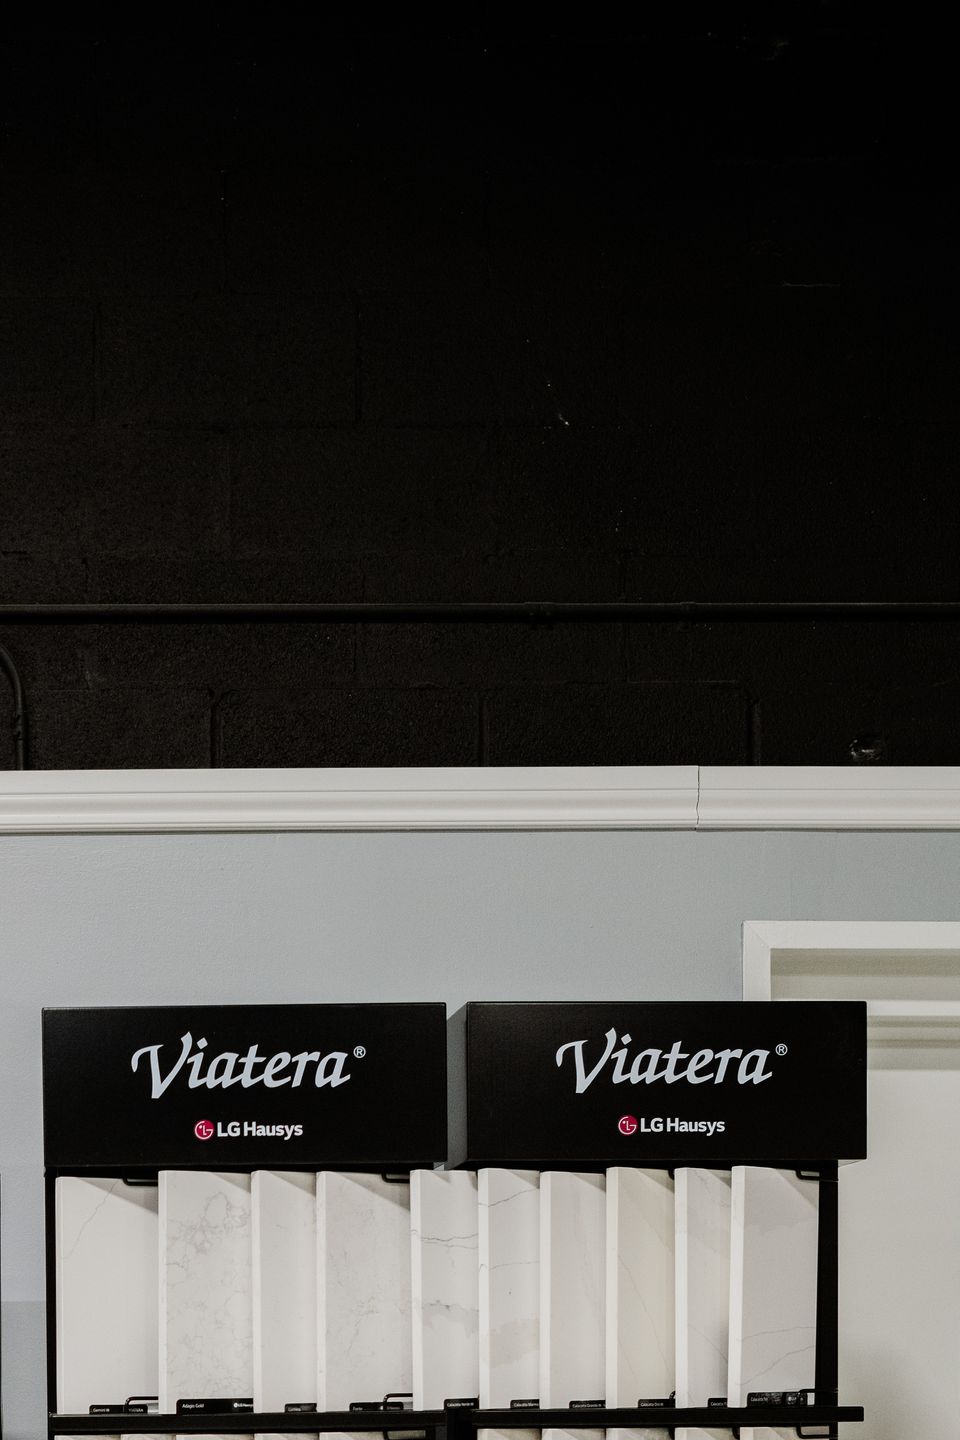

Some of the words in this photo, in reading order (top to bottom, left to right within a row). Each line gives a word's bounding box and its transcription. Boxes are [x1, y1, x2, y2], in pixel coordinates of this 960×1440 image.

[217, 1121, 240, 1137] LG
[244, 1121, 303, 1140] Hausys
[641, 1118, 663, 1132] LG
[667, 1118, 725, 1136] Hausys
